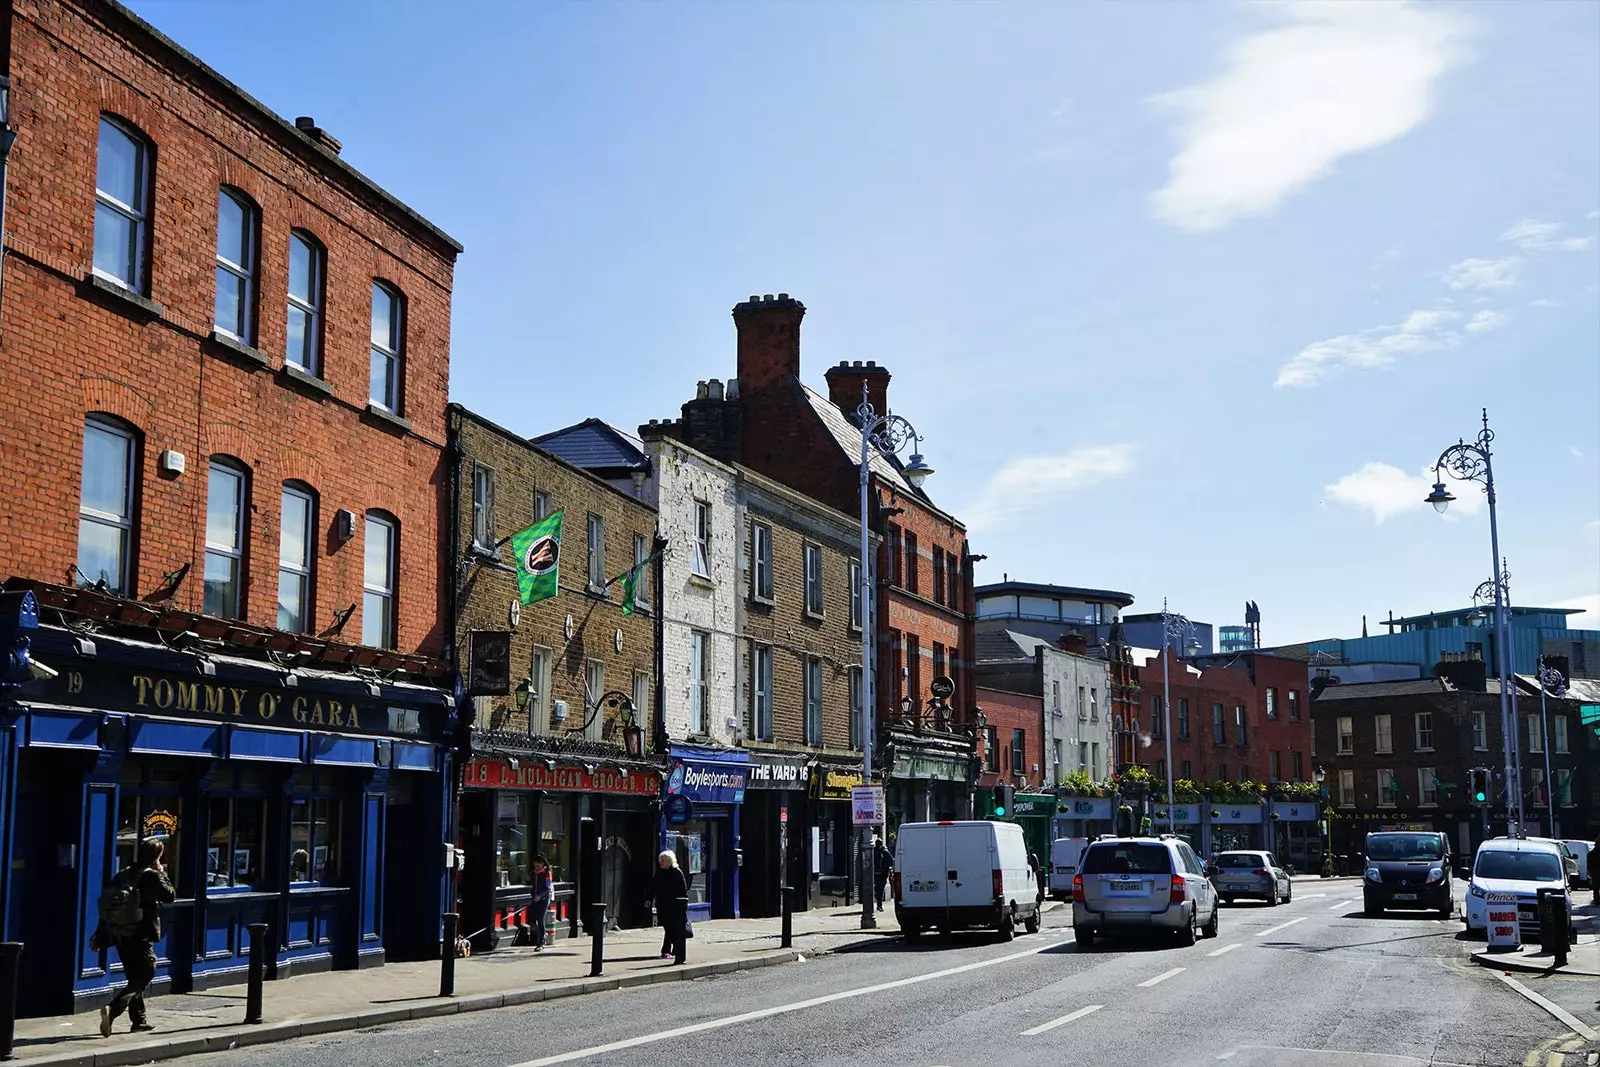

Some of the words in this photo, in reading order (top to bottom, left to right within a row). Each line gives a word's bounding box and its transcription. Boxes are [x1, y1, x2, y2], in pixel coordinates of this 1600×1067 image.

[67, 671, 83, 693] 19
[132, 675, 248, 717] TOMMY
[258, 691, 281, 719] O'
[292, 696, 360, 729] GARA
[468, 760, 487, 782] 18
[643, 776, 656, 792] 18
[750, 764, 769, 780] THE
[772, 764, 797, 781] YARD
[799, 767, 809, 781] 16
[1487, 893, 1517, 901] Prince
[1495, 926, 1513, 936] SHOP
